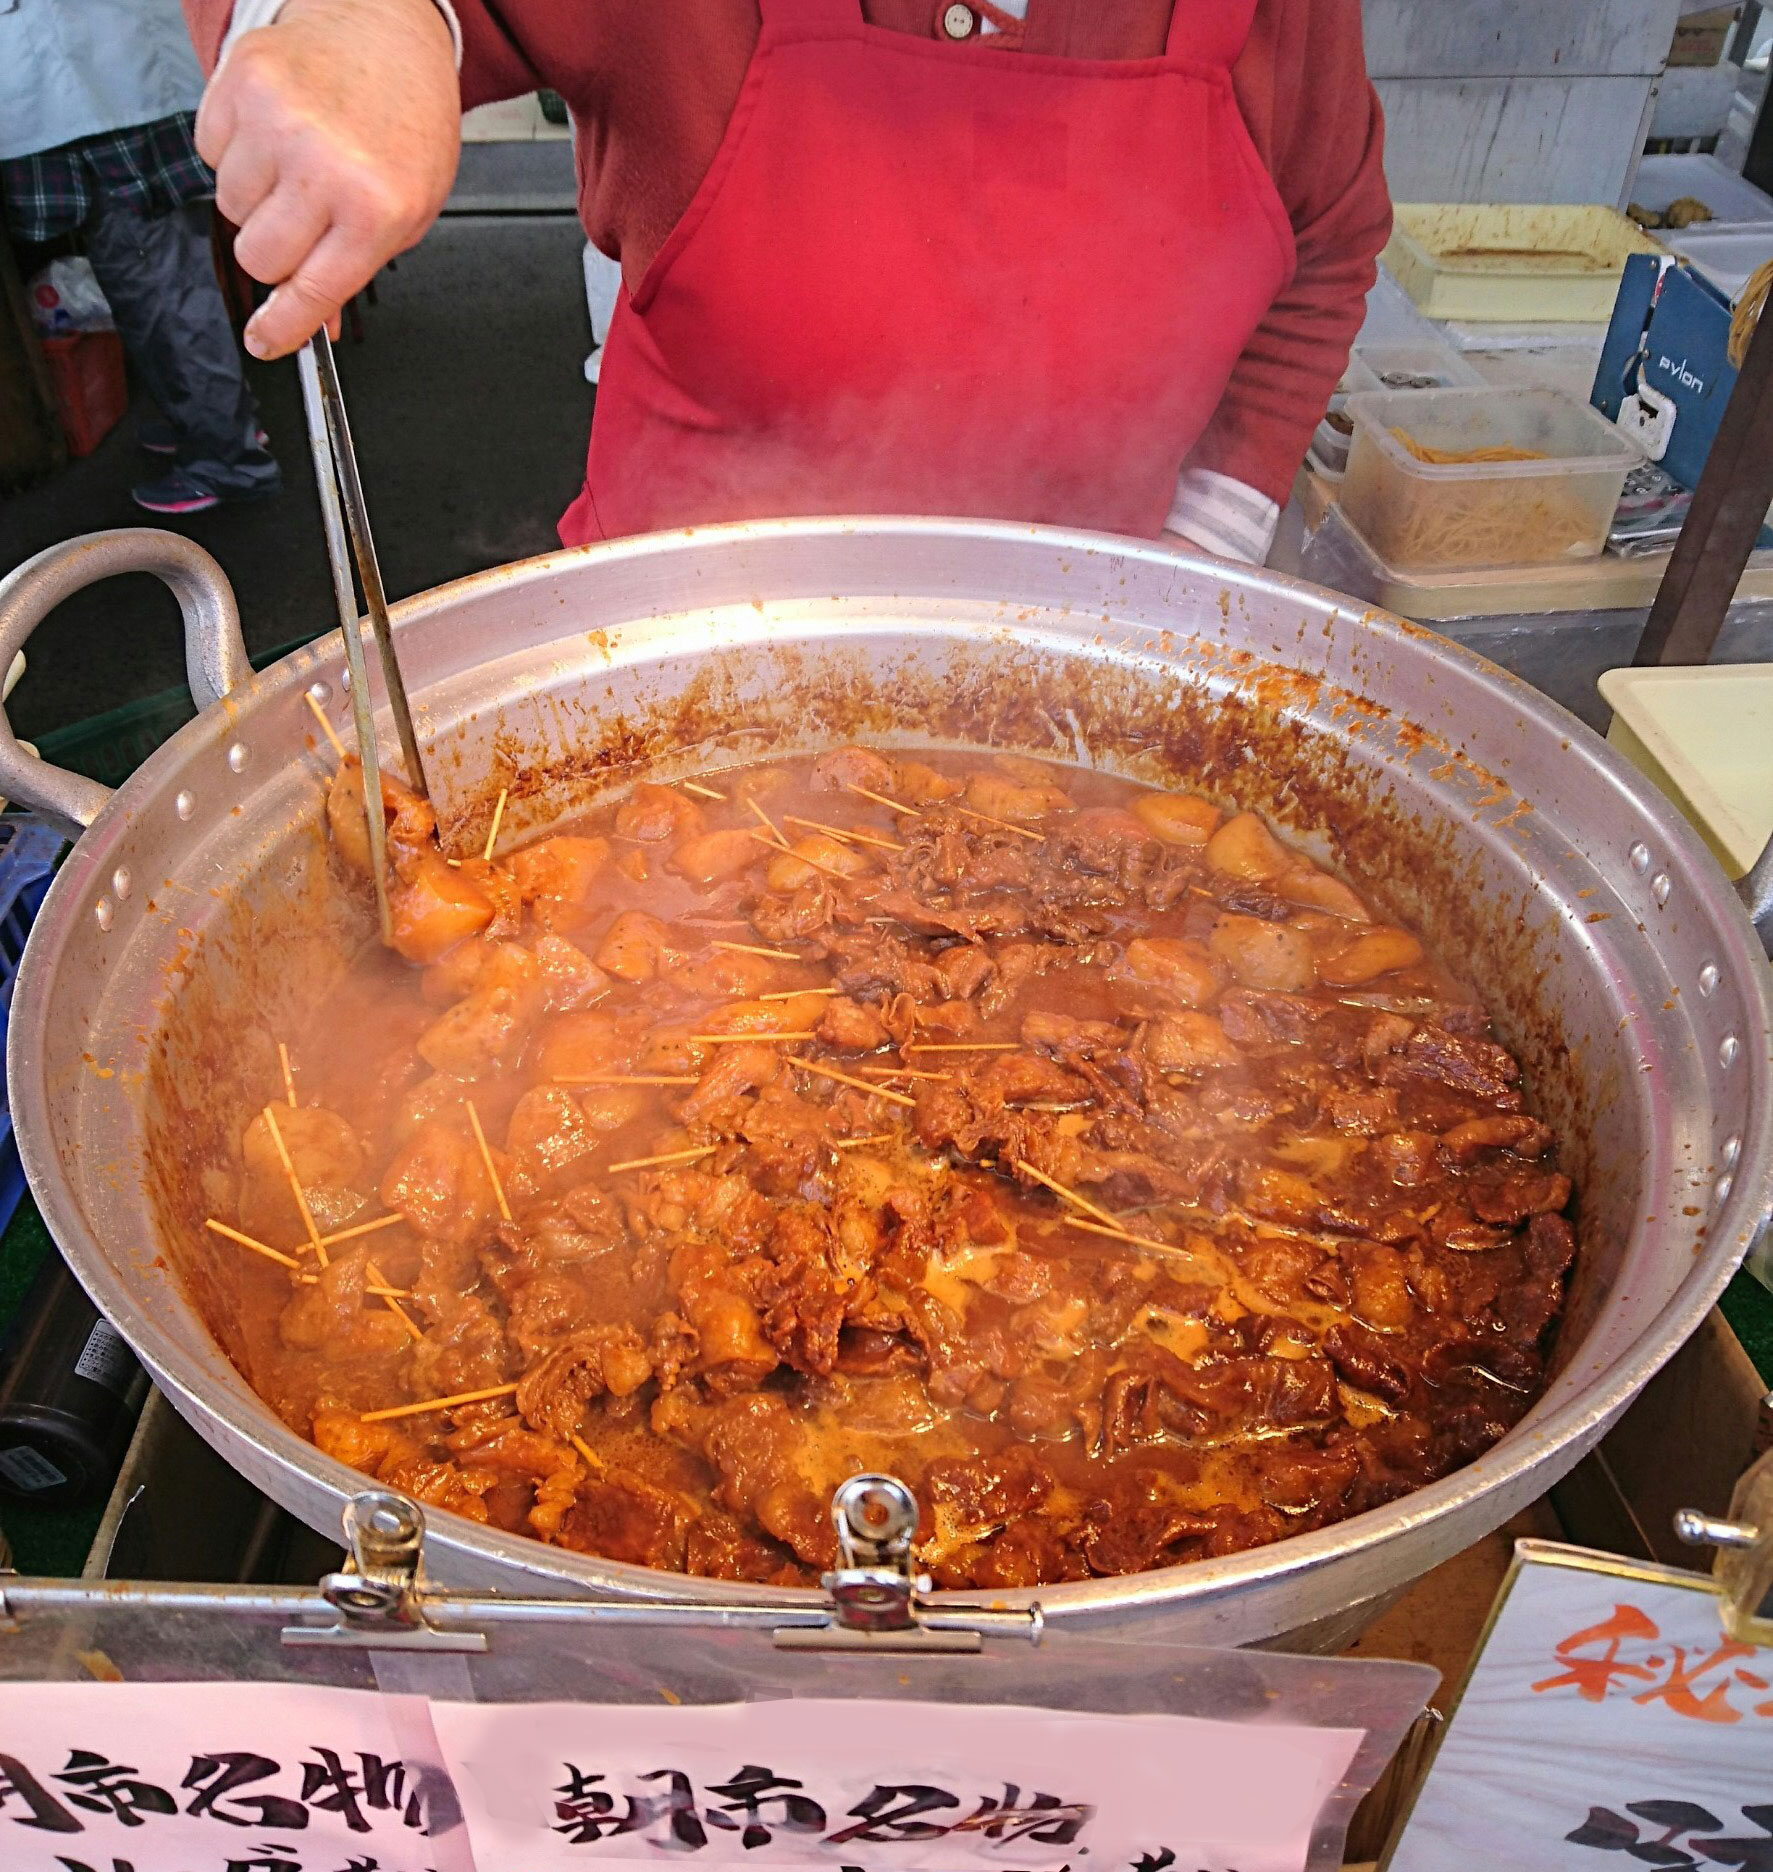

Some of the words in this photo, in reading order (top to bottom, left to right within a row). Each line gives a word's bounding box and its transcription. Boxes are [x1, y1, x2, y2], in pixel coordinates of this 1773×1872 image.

[1659, 356, 1704, 394] pylon
[551, 1762, 1097, 1850] 朝市名物
